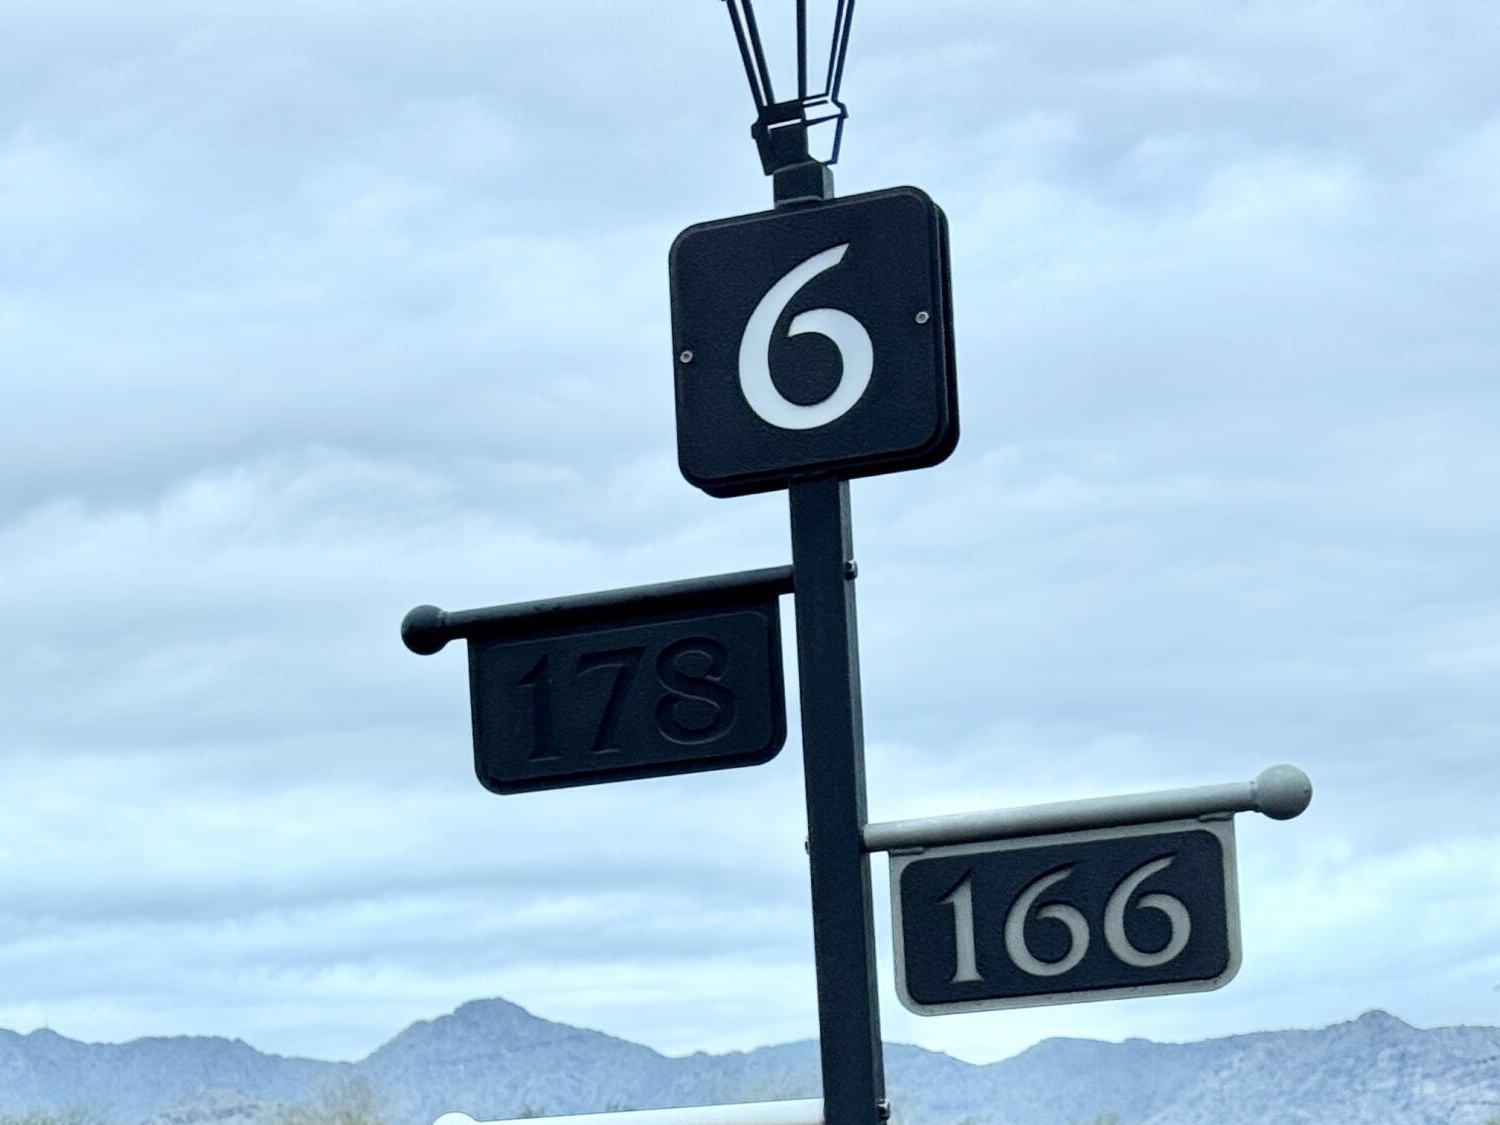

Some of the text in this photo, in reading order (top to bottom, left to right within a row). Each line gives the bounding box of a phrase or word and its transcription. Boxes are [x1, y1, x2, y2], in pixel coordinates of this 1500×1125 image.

[738, 242, 874, 431] 6
[517, 635, 736, 763] 178
[937, 852, 1192, 985] 166
